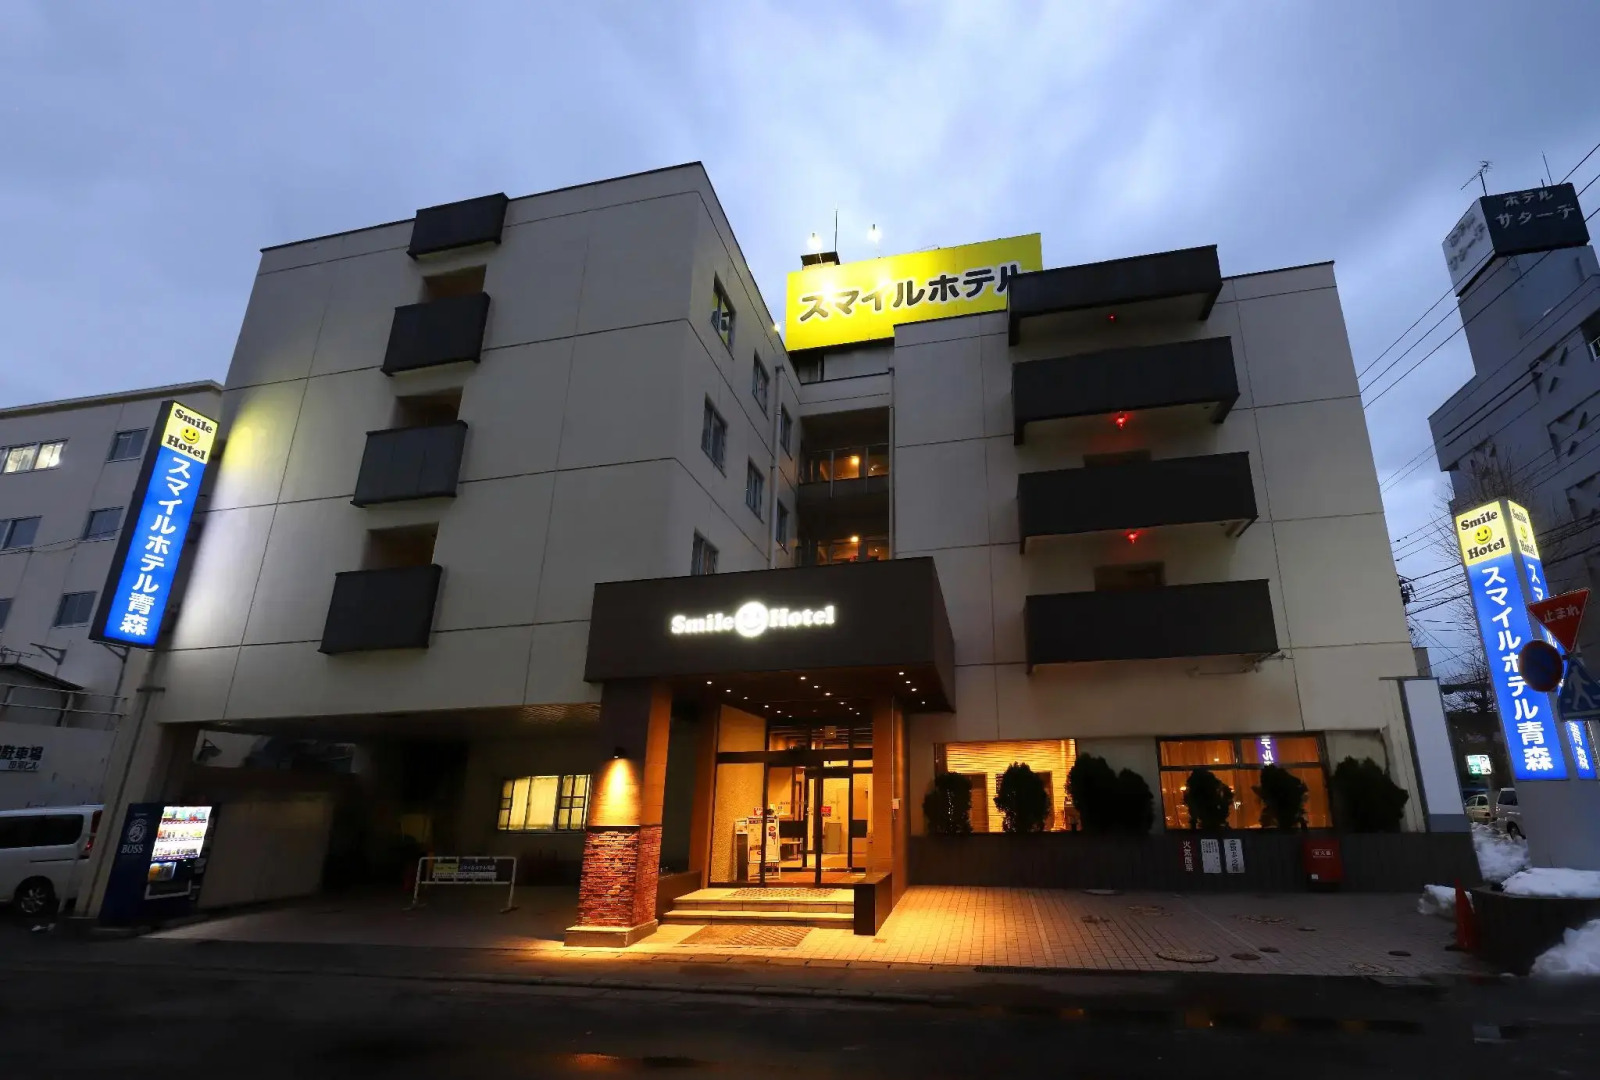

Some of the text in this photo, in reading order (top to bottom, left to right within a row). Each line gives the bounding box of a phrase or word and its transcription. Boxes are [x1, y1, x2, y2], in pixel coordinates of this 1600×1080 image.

[1503, 189, 1554, 208] ホテル
[174, 408, 213, 434] Smile
[165, 434, 206, 461] Hotel
[1460, 510, 1498, 531] Smile
[119, 456, 191, 636] スマイルホテル青森
[1467, 538, 1506, 560] Hotel
[671, 605, 835, 635] Smile Hotel
[1544, 604, 1580, 624] 止まれ
[1481, 566, 1554, 771] スマイルホテル青森
[0, 744, 44, 761] 駐車場
[121, 844, 144, 854] BOSS
